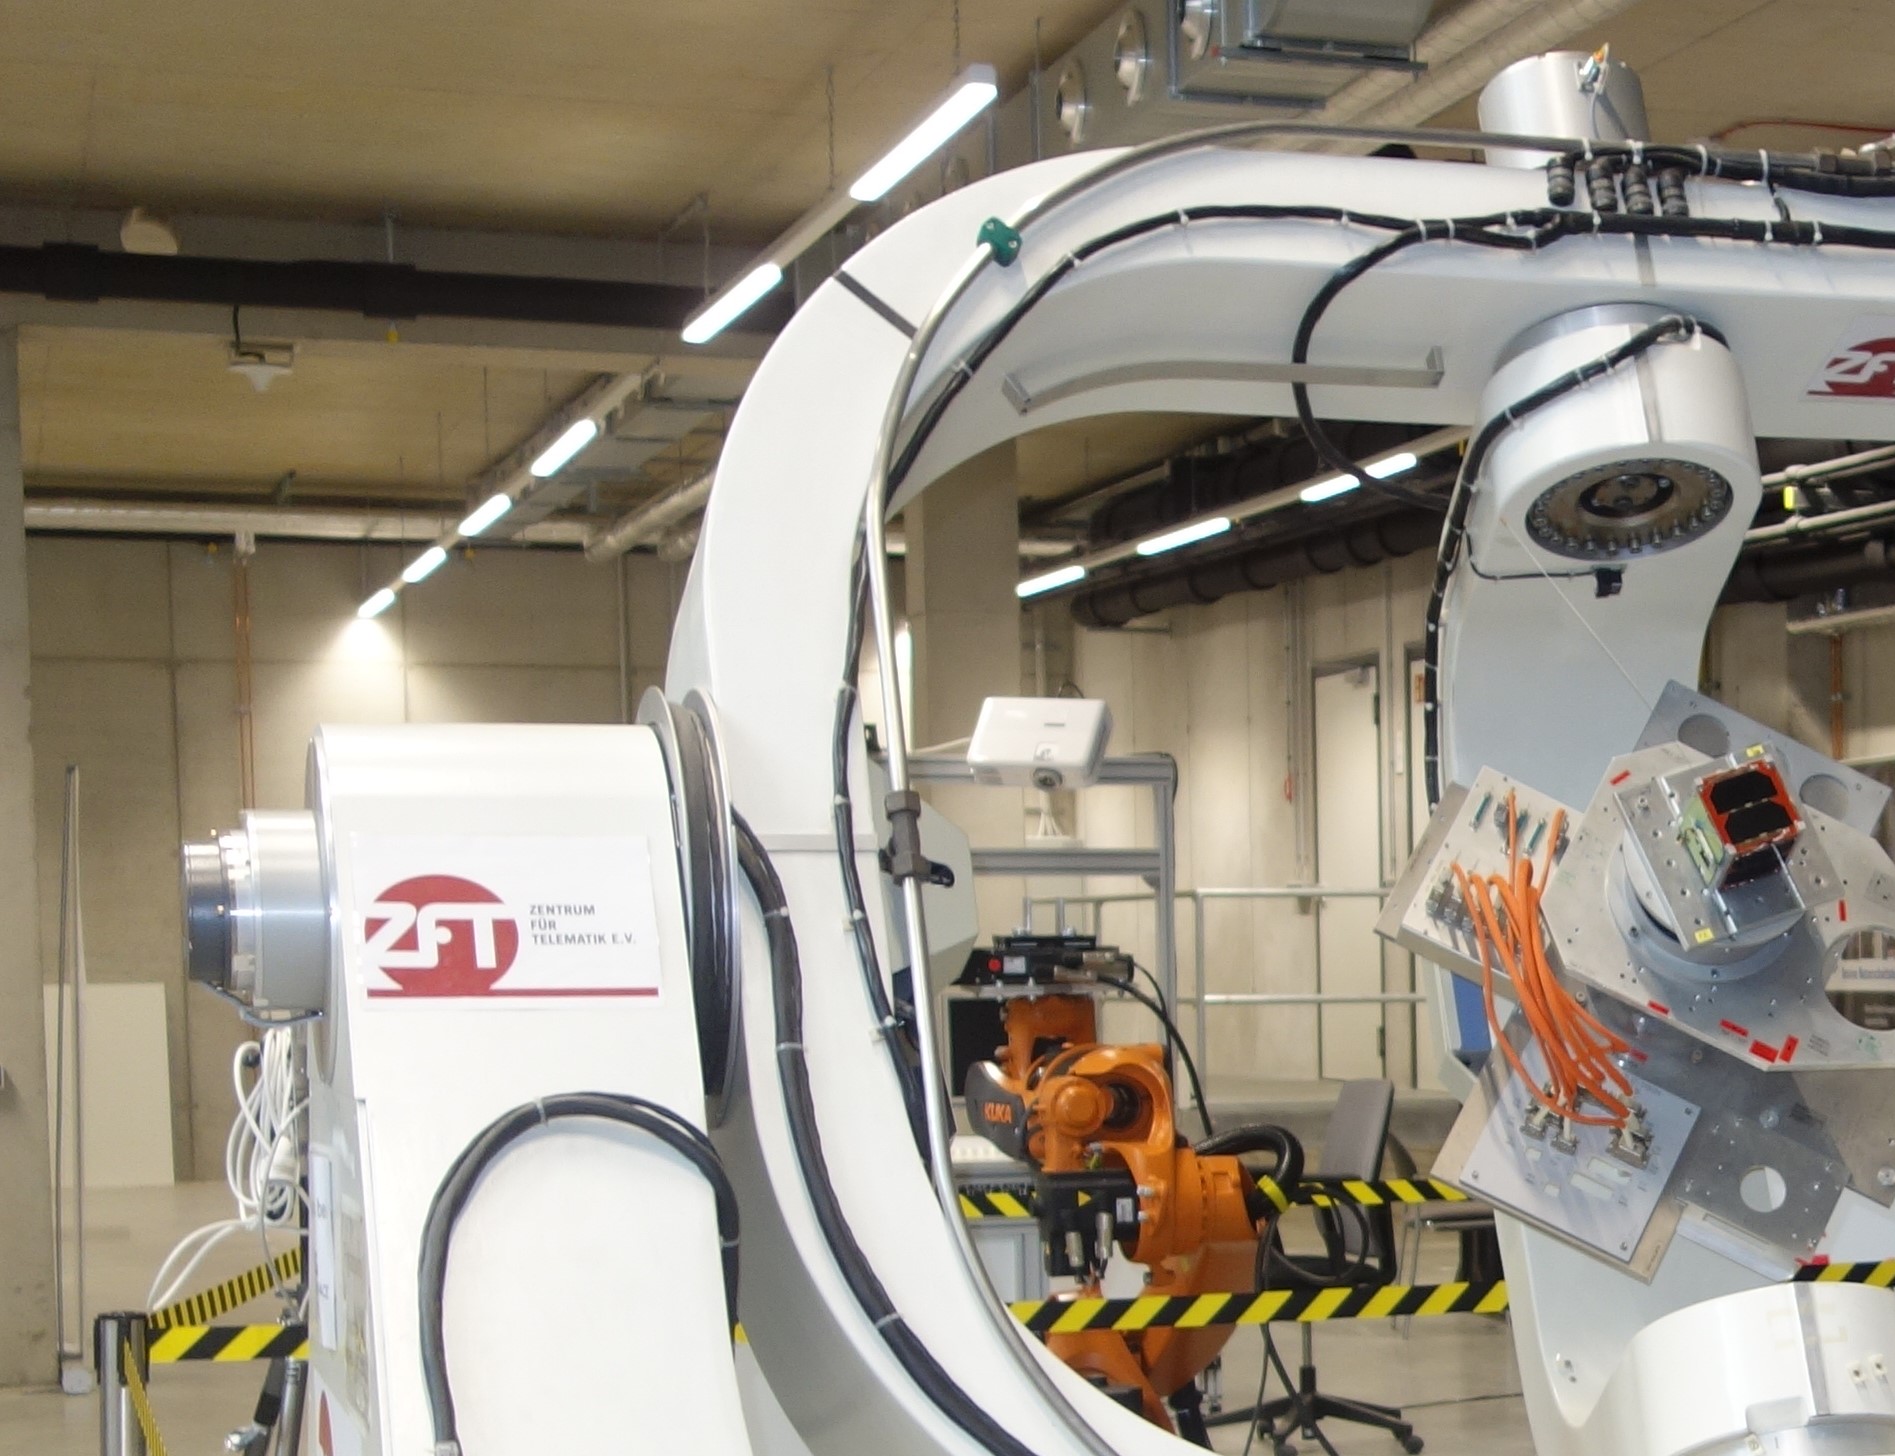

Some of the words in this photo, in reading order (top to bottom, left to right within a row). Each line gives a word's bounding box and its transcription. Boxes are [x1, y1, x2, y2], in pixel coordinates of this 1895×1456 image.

[529, 904, 595, 916] ZENTRUM
[530, 917, 556, 931] FÜR
[364, 901, 516, 969] ZFT
[532, 932, 606, 945] TELEMATIK
[611, 932, 637, 945] E.V.
[984, 1102, 1012, 1124] KUKA
